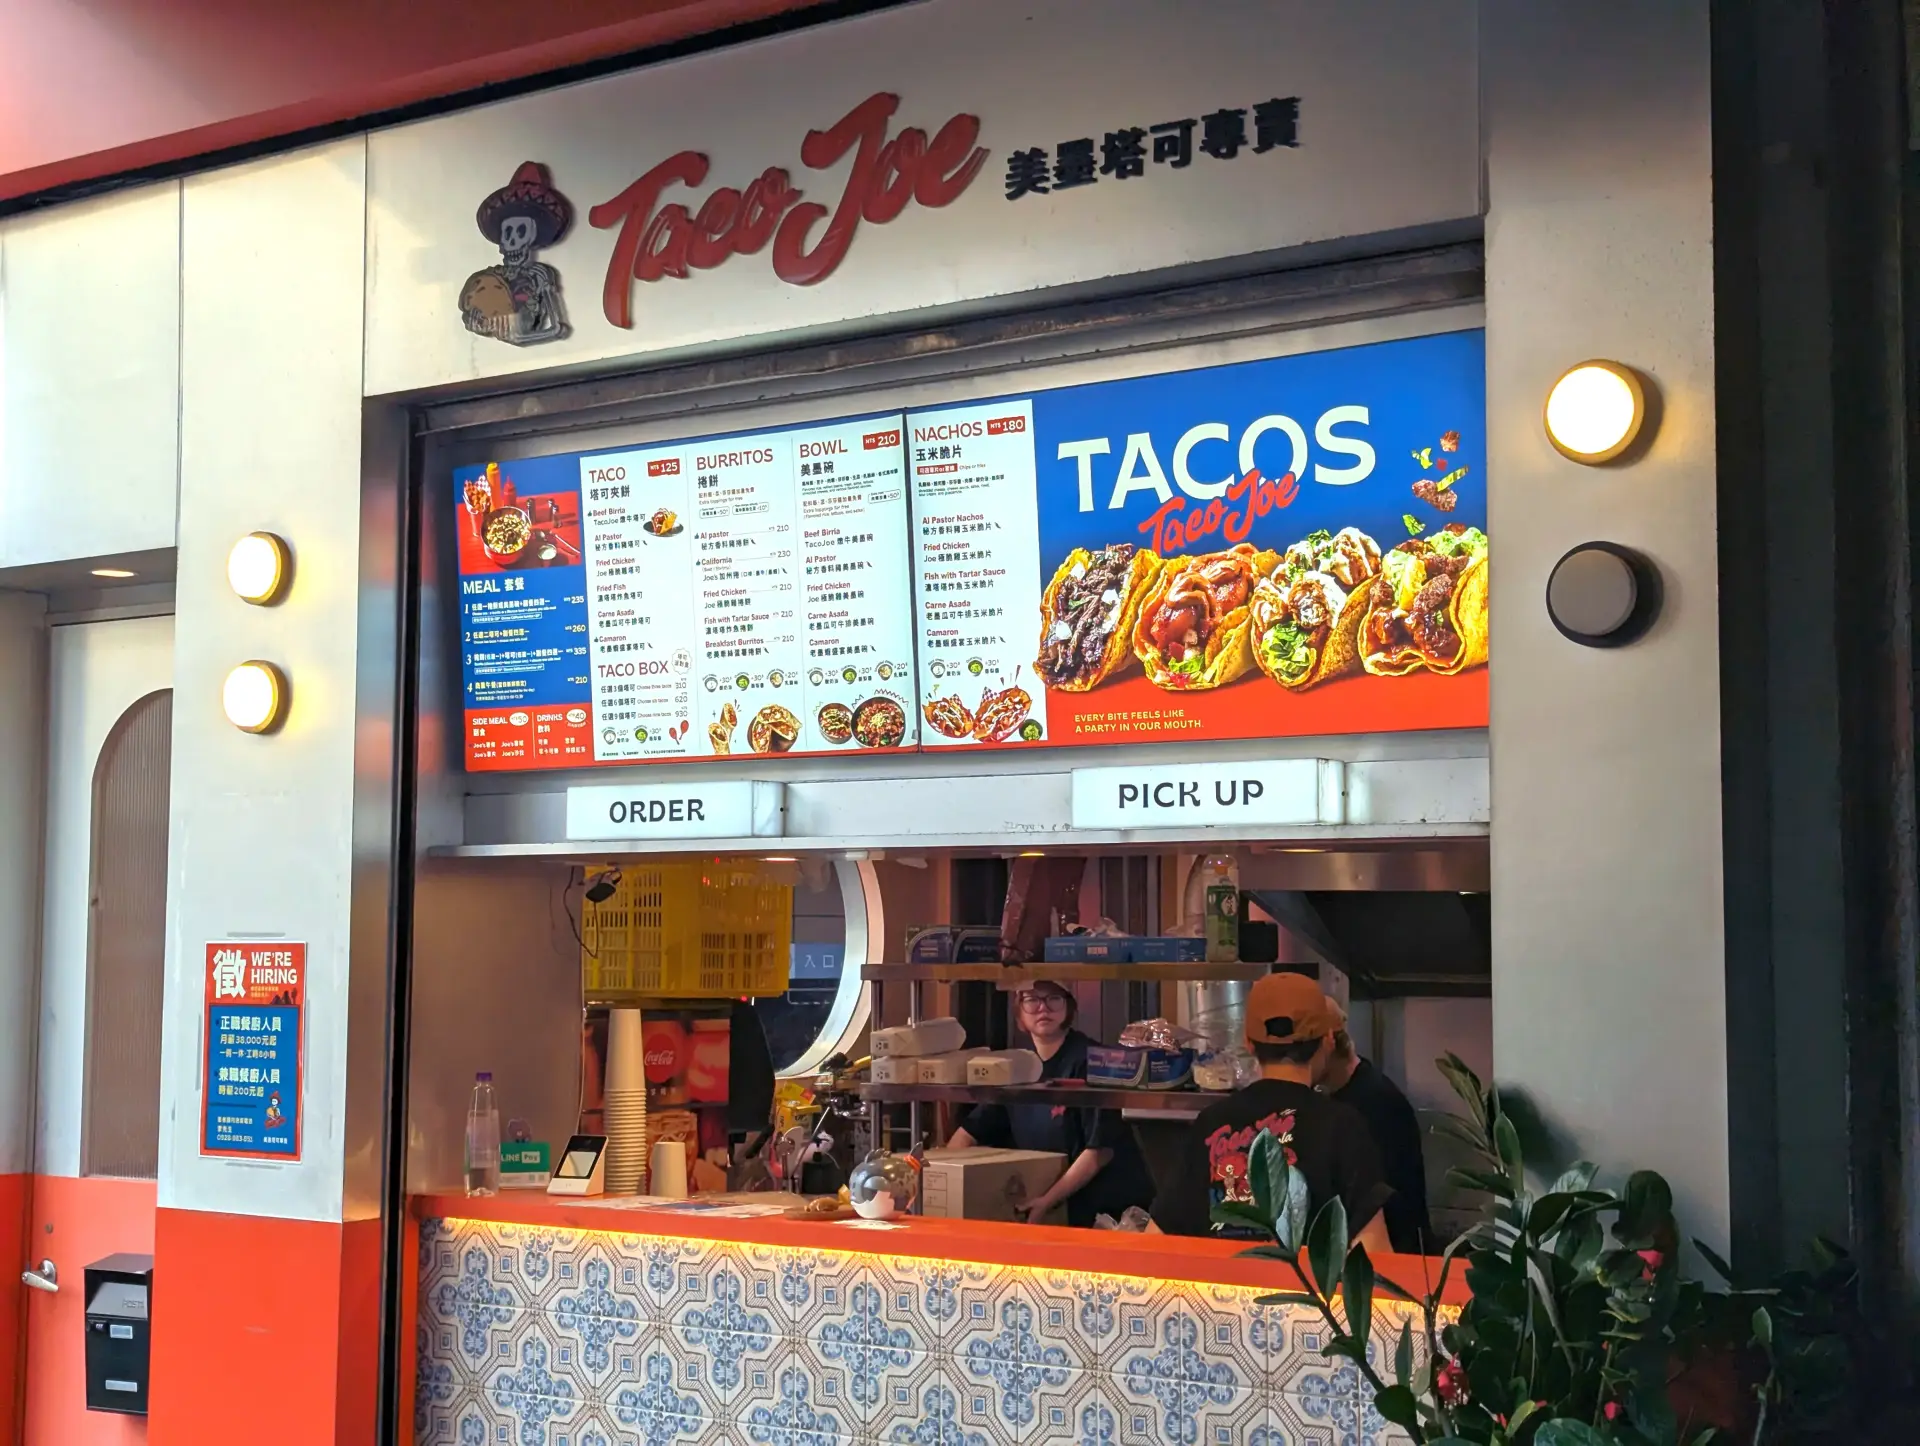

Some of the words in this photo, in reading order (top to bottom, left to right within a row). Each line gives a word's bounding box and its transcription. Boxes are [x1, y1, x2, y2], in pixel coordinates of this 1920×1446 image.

[1005, 96, 1303, 201] 美墨塔可專賣
[590, 149, 803, 329] Taco
[772, 91, 991, 286] Joe
[914, 422, 983, 443] NACHOS
[1003, 419, 1024, 431] 180
[799, 439, 848, 458] BOWL
[878, 434, 896, 446] 210
[915, 444, 962, 462] 玉米脆片
[697, 448, 774, 471] BURRITOS
[1057, 404, 1376, 513] TACOS
[589, 466, 626, 484] TACO
[661, 462, 678, 473] 125
[800, 460, 835, 477] 美墨碗
[698, 474, 719, 489] 捲餅
[590, 485, 630, 501] 塔可夾餅
[593, 508, 607, 517] Beef
[608, 507, 626, 515] Birria
[922, 517, 930, 525] Al
[931, 515, 955, 524] Pastor
[956, 513, 984, 522] Nachos
[1138, 496, 1229, 558] Taco
[1223, 468, 1300, 543] Joe
[602, 533, 622, 541] Pastor
[708, 531, 729, 540] pastor
[776, 524, 789, 532] 210
[804, 529, 820, 538] Beef
[821, 527, 840, 536] Birria
[804, 540, 835, 548] TacoJoe
[923, 543, 941, 551] Fried
[942, 541, 970, 550] Chicken
[596, 559, 611, 567] Fried
[611, 557, 635, 565] Chicken
[701, 557, 732, 566] California
[777, 550, 791, 558] 230
[805, 556, 813, 564] Al
[924, 555, 937, 563] Joe
[924, 572, 939, 580] Fish
[940, 571, 957, 579] with
[959, 570, 981, 578] Tartar
[982, 568, 1006, 576] Sauce
[463, 579, 501, 594] MEAL
[504, 577, 525, 591] 套餐
[613, 583, 626, 591] Fish
[703, 589, 719, 598] Fried
[720, 588, 747, 596] Chicken
[779, 583, 792, 591] 210
[807, 584, 823, 592] Fried
[824, 582, 851, 590] Chicken
[464, 603, 469, 614] 1
[571, 595, 585, 604] 235
[704, 601, 715, 609] Joe
[925, 601, 947, 609] Carne
[948, 599, 971, 608] Asada
[598, 610, 615, 618] Carne
[704, 617, 717, 625] Fish
[718, 615, 731, 623] with
[731, 614, 750, 622] Tartar
[751, 613, 770, 621] Sauce
[780, 610, 793, 618] 210
[807, 611, 827, 619] Carne
[828, 610, 849, 618] Asada
[465, 632, 471, 642] 2
[572, 624, 586, 633] 260
[926, 628, 959, 637] Camaron
[705, 640, 736, 649] Breakfast
[737, 638, 764, 646] Burritos
[809, 638, 839, 646] Camaron
[466, 654, 472, 665] 3
[573, 647, 587, 655] 335
[598, 662, 635, 678] TACO
[638, 660, 669, 676] BOX
[467, 682, 473, 693] 4
[575, 676, 588, 684] 210
[675, 681, 687, 689] 310
[674, 695, 688, 703] 620
[472, 718, 488, 726] SIDE
[489, 716, 508, 725] MEAL
[536, 714, 563, 722] DRINKS
[675, 710, 688, 718] 930
[1074, 713, 1105, 723] EVERY
[1107, 712, 1128, 721] BITE
[1130, 710, 1161, 720] FEELS
[1163, 709, 1184, 718] LIKE
[1075, 725, 1082, 733] A
[1084, 723, 1116, 733] PARTY
[1119, 722, 1130, 731] IN
[1133, 721, 1161, 731] YOUR
[1118, 782, 1201, 809] PICK
[1215, 779, 1264, 806] UP
[609, 798, 705, 824] ORDER
[250, 951, 292, 967] WE'RE
[804, 954, 835, 968] 入口
[212, 949, 247, 999] 徵
[250, 968, 298, 985] HIRING
[501, 1154, 521, 1162] LINE
